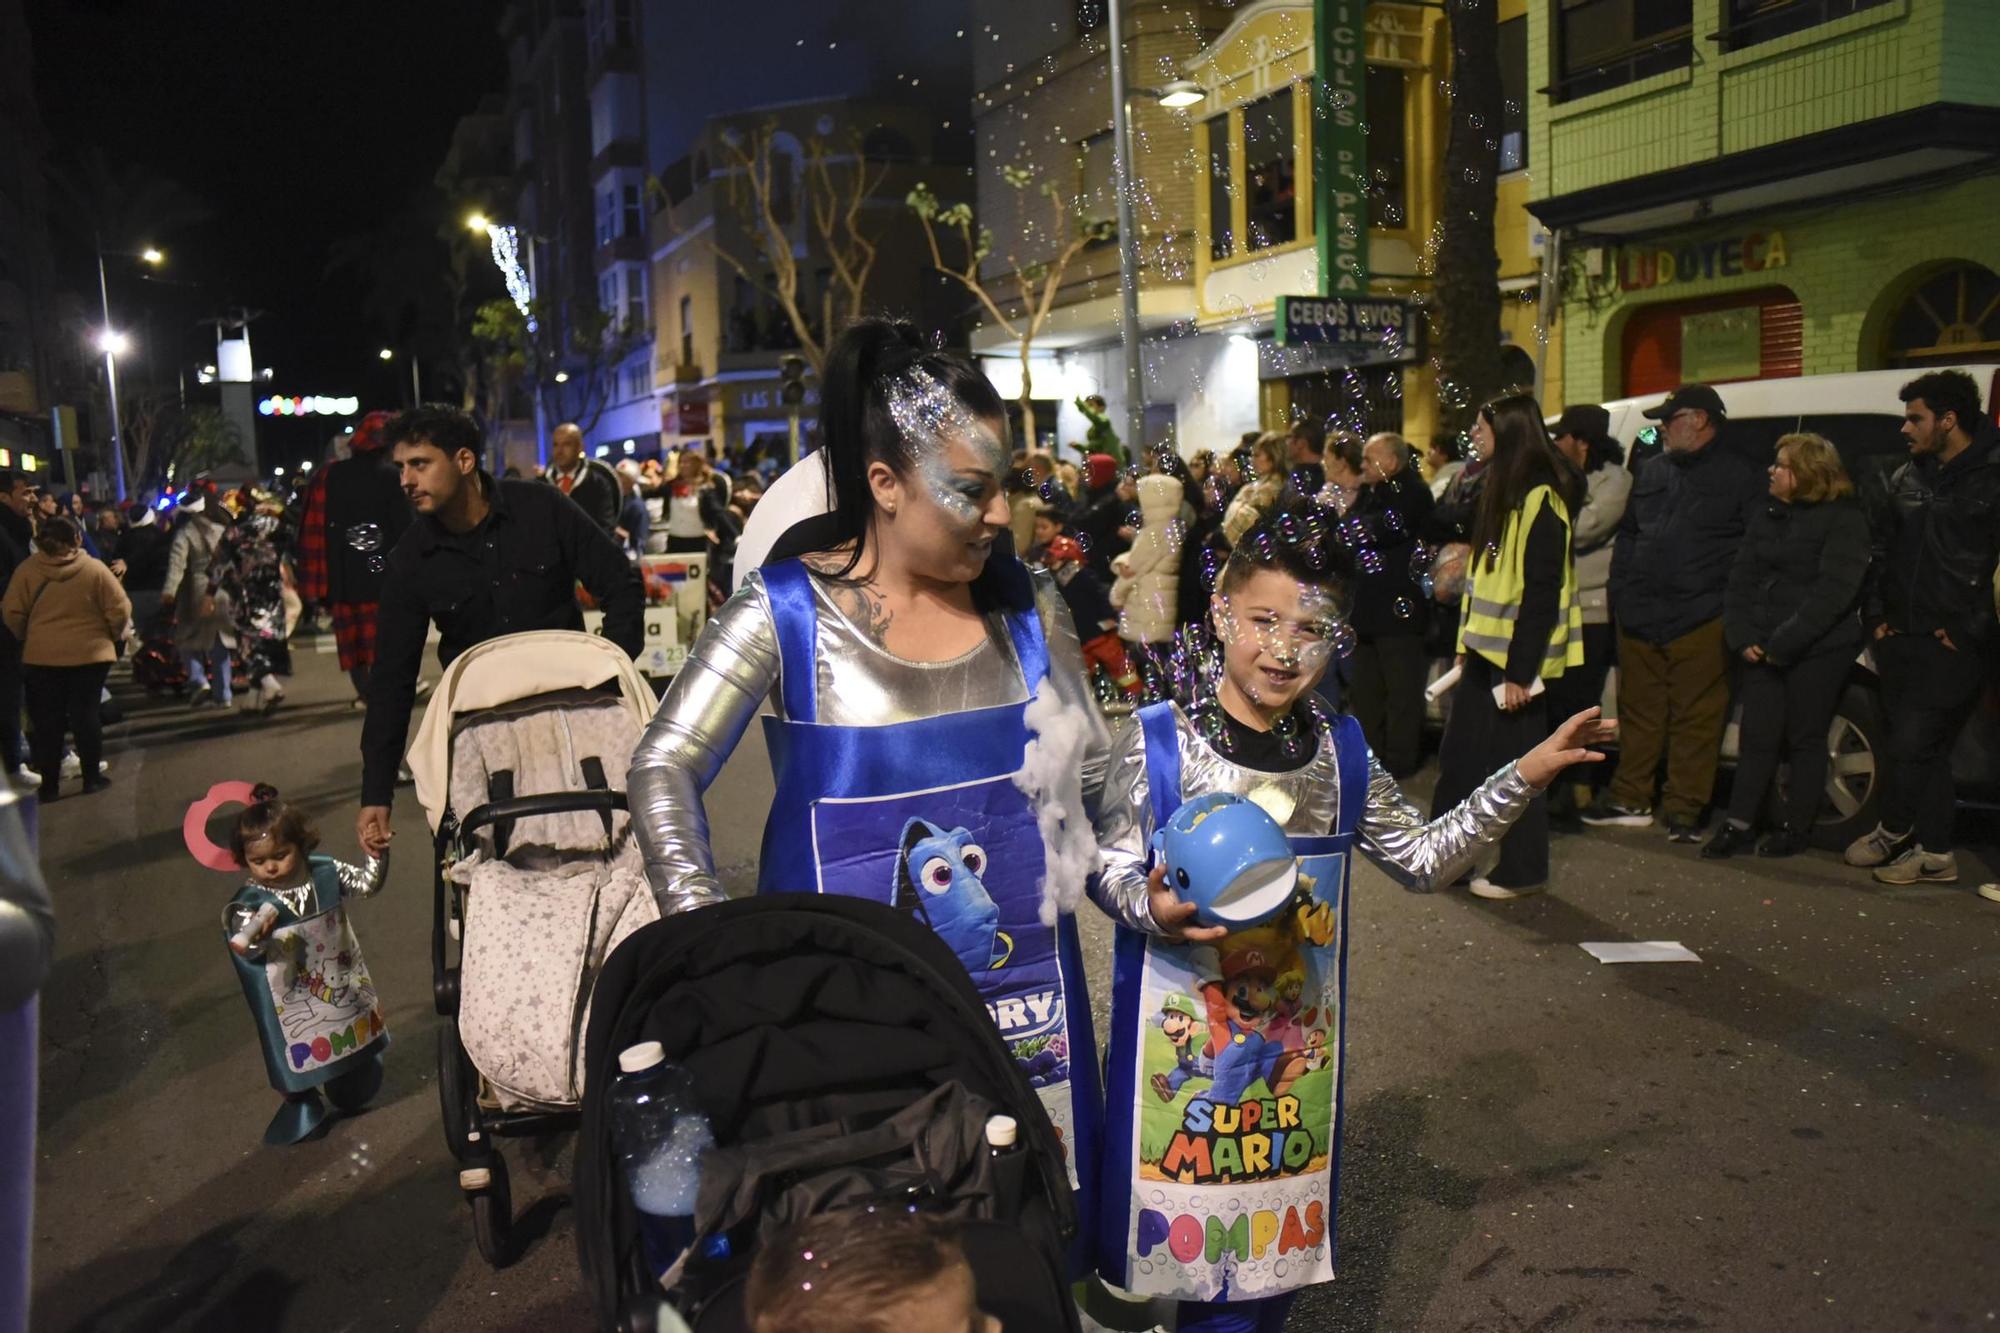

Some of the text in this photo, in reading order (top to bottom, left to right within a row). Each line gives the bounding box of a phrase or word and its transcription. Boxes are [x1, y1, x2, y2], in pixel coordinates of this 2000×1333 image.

[1336, 192, 1358, 291] PESCA
[1619, 231, 1788, 291] LUDOTECA
[1289, 301, 1403, 327] CEBOS VIVOS
[1338, 328, 1357, 342] 24
[666, 648, 684, 662] 23
[1182, 1094, 1301, 1135] SUPER
[1161, 1128, 1315, 1180] MARIO
[1136, 1200, 1325, 1264] POMPAS
